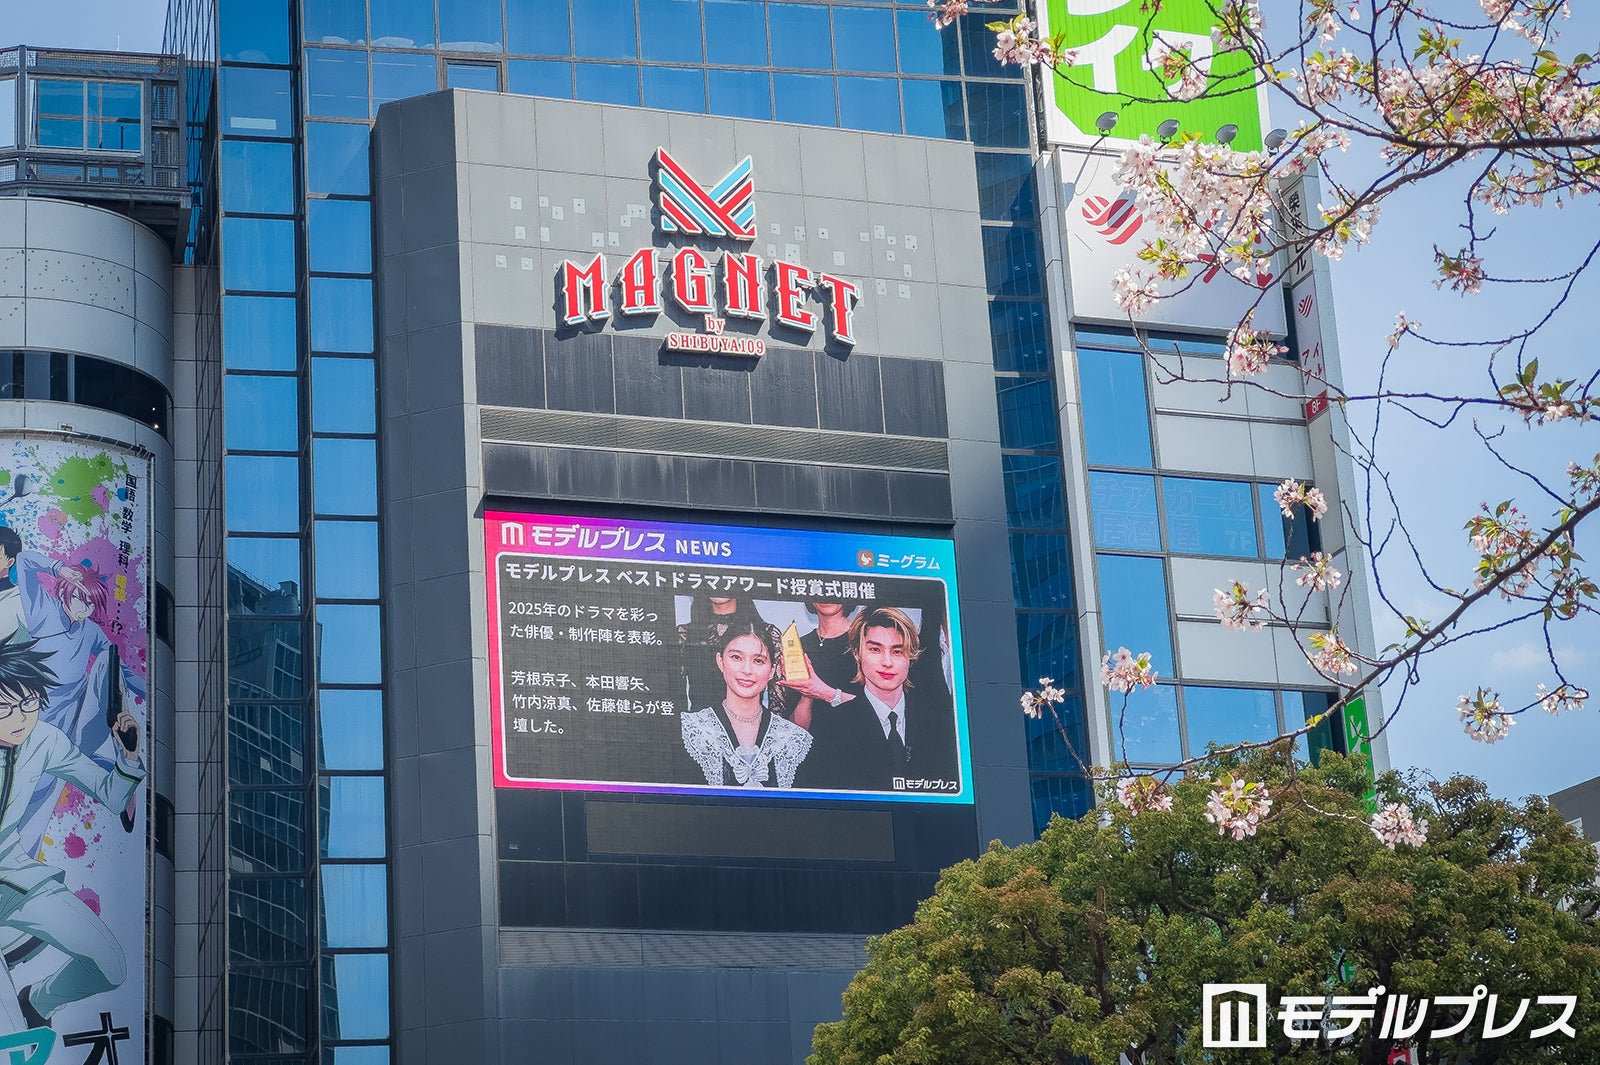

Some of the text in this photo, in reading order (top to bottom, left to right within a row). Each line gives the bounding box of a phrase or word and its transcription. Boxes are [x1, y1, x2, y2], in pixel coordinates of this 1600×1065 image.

[564, 247, 859, 345] MAGNET
[705, 314, 725, 333] by
[668, 332, 766, 356] SHIBUYA109
[532, 524, 733, 557] モデルプレス NEWS
[877, 553, 941, 570] ミーグラム
[505, 562, 876, 599] モデルプレス ベストドラマアワード授賞式開催
[508, 601, 658, 622] 2025年のドラマを彩っ
[510, 624, 663, 646] た俳優・制作陣を表彰。
[511, 670, 650, 691] 芳根京子、本田響矢、
[512, 694, 675, 715] 竹内涼真、佐藤健らが登
[905, 778, 958, 790] モデルプレス
